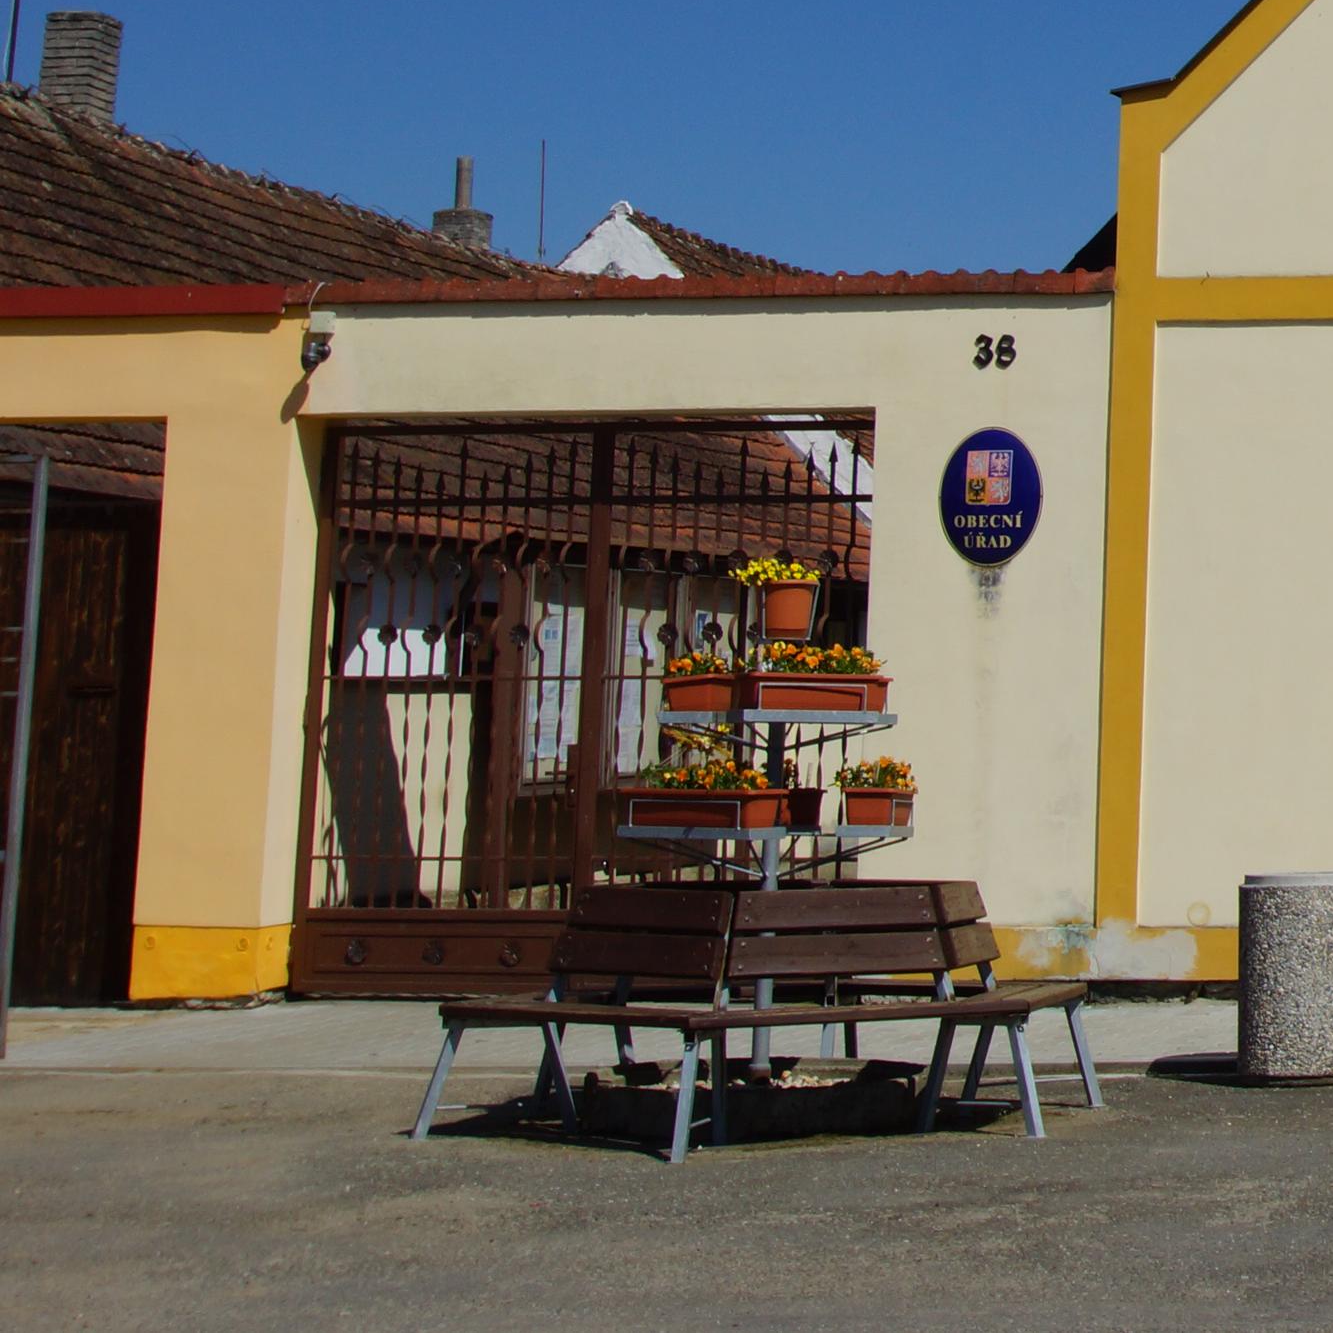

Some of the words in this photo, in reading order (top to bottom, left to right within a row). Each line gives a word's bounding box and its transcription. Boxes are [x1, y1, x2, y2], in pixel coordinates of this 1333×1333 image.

[972, 333, 1017, 370] 38
[954, 510, 1023, 528] OBECNÍ
[963, 531, 1012, 548] ÚŘAD
